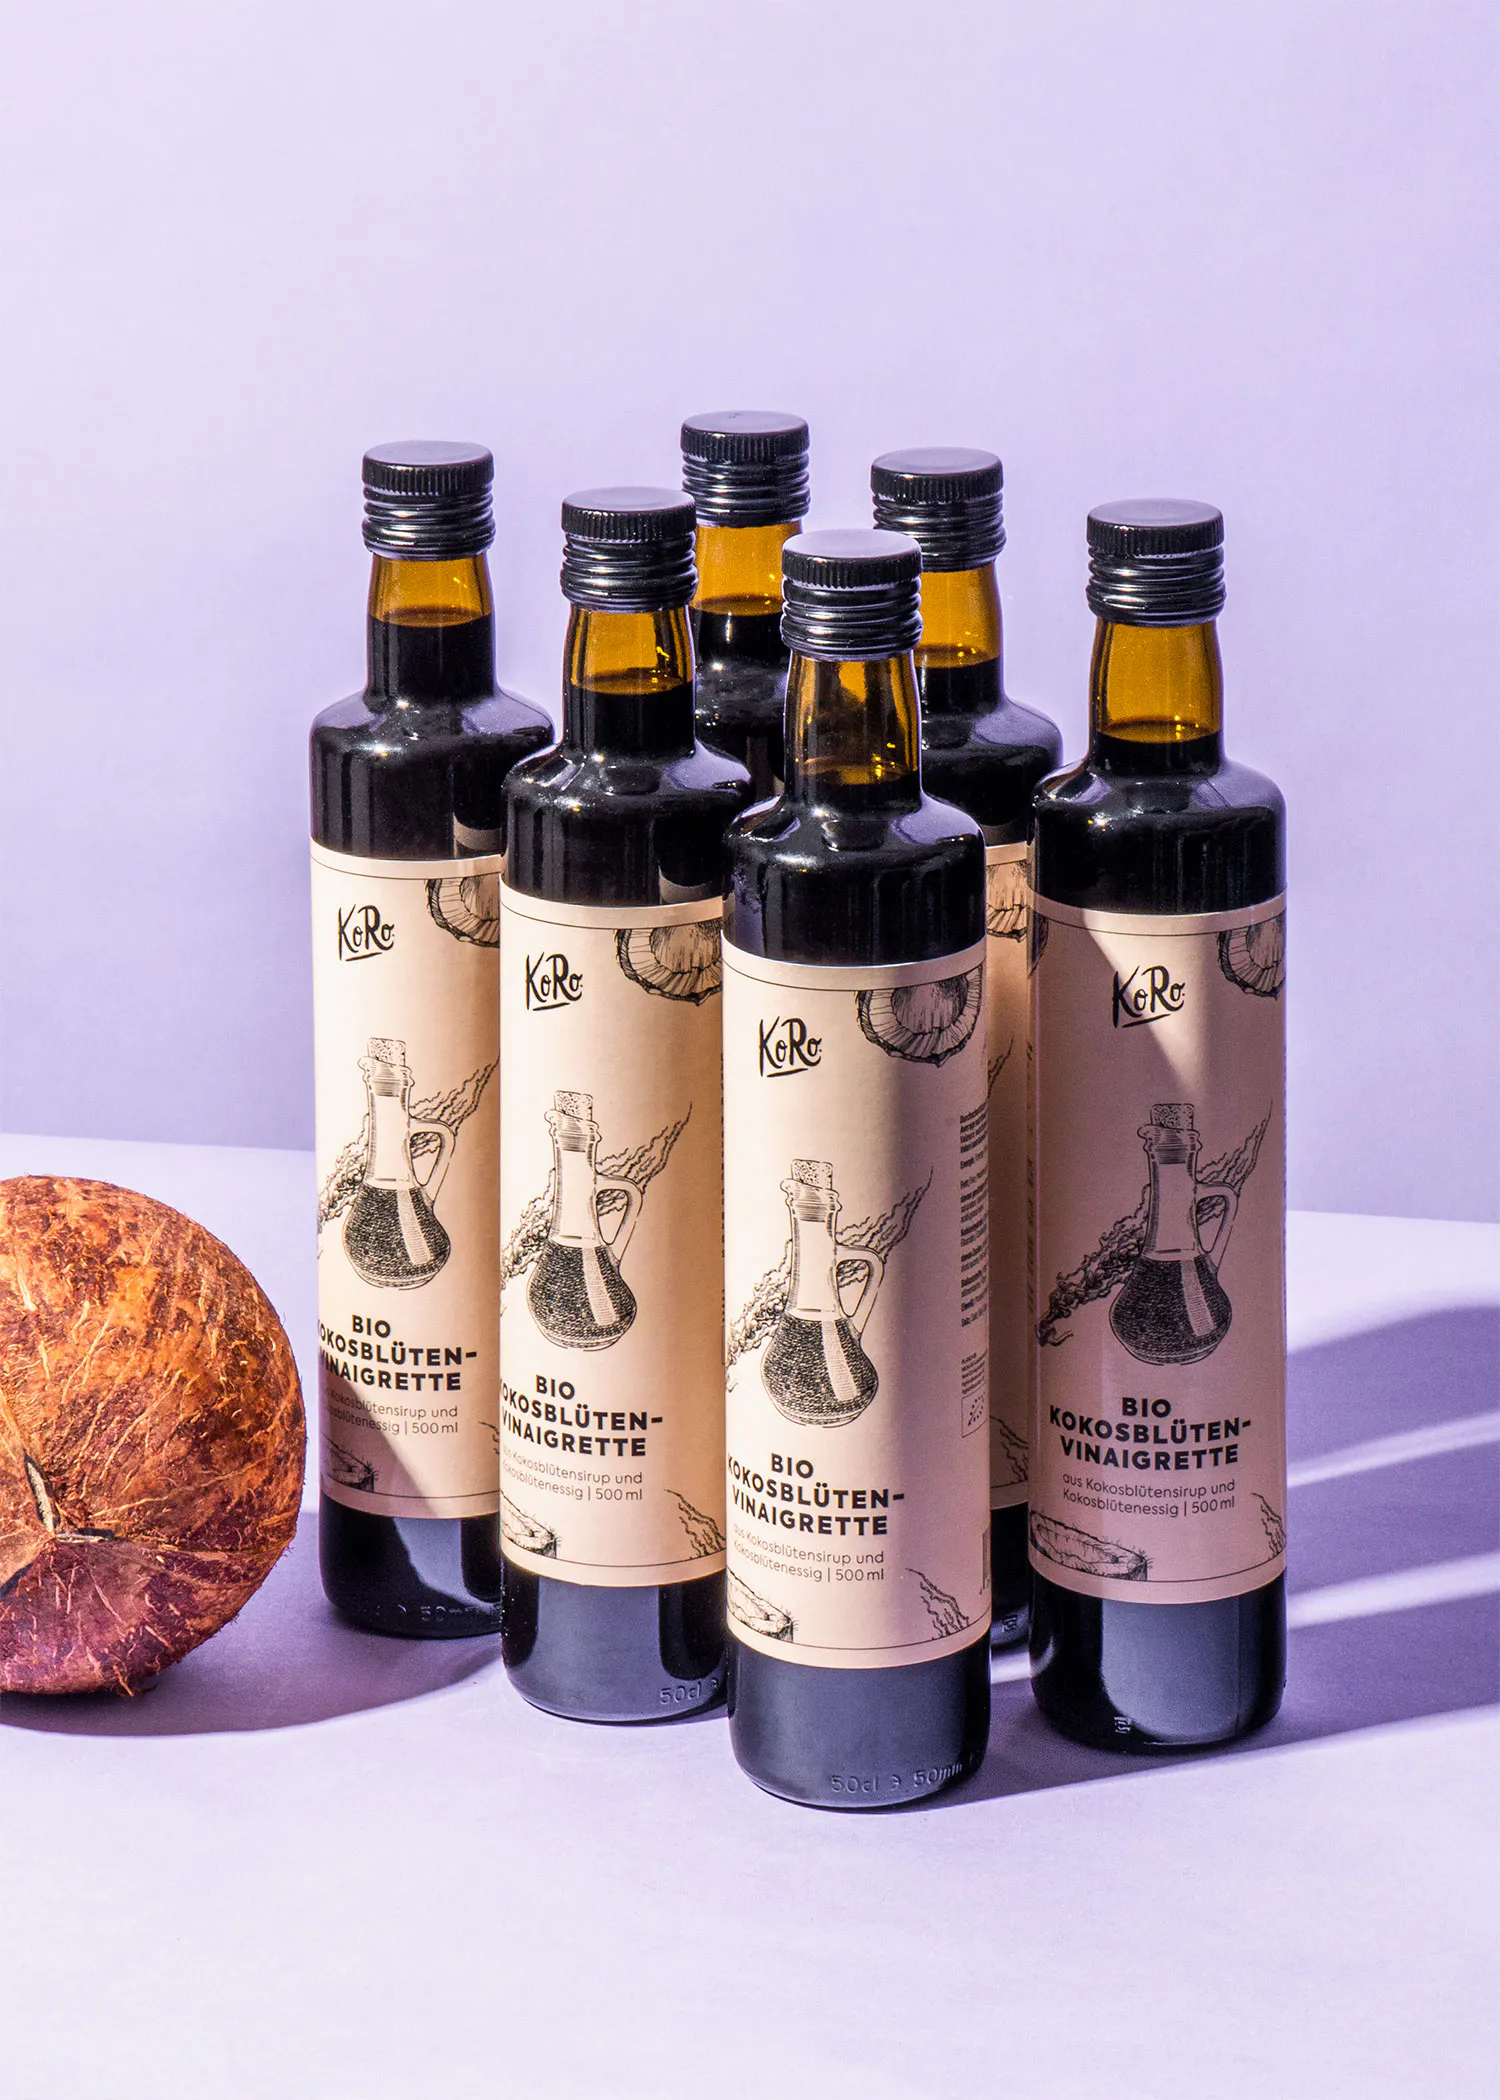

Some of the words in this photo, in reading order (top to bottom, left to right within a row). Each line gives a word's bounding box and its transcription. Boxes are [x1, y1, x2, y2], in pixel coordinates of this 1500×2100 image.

[338, 904, 395, 961] KoRo
[525, 951, 583, 1011] KoRo
[1112, 965, 1185, 1028] KoRo
[759, 1016, 822, 1077] KoRo
[318, 1319, 477, 1366] OKOSBLÜTEN-
[352, 1314, 391, 1338] BIO
[536, 1374, 575, 1400] BIO
[432, 1405, 458, 1418] und
[1050, 1405, 1251, 1444] KOKOSBLÜTEN-
[1122, 1397, 1171, 1418] BIO
[502, 1405, 647, 1457] VINAIGRETTE
[513, 1452, 611, 1485] Kokosblütensirup
[615, 1471, 642, 1485] und
[771, 1453, 814, 1479] BIO
[1060, 1435, 1239, 1470] VINAIGRETTE
[728, 1453, 905, 1509] KOKOSBLÜTEN-
[1062, 1473, 1083, 1487] aus
[1086, 1478, 1206, 1499] Kokosblütensirup
[1211, 1479, 1235, 1494] und
[732, 1485, 888, 1536] VINAIGRETTE
[1063, 1488, 1179, 1518] Kokosblütenessig
[734, 1540, 822, 1582] Kokosblütenessig
[746, 1531, 852, 1566] Kokosblütensirup
[856, 1550, 884, 1564] und
[830, 1774, 878, 1793] 50cl
